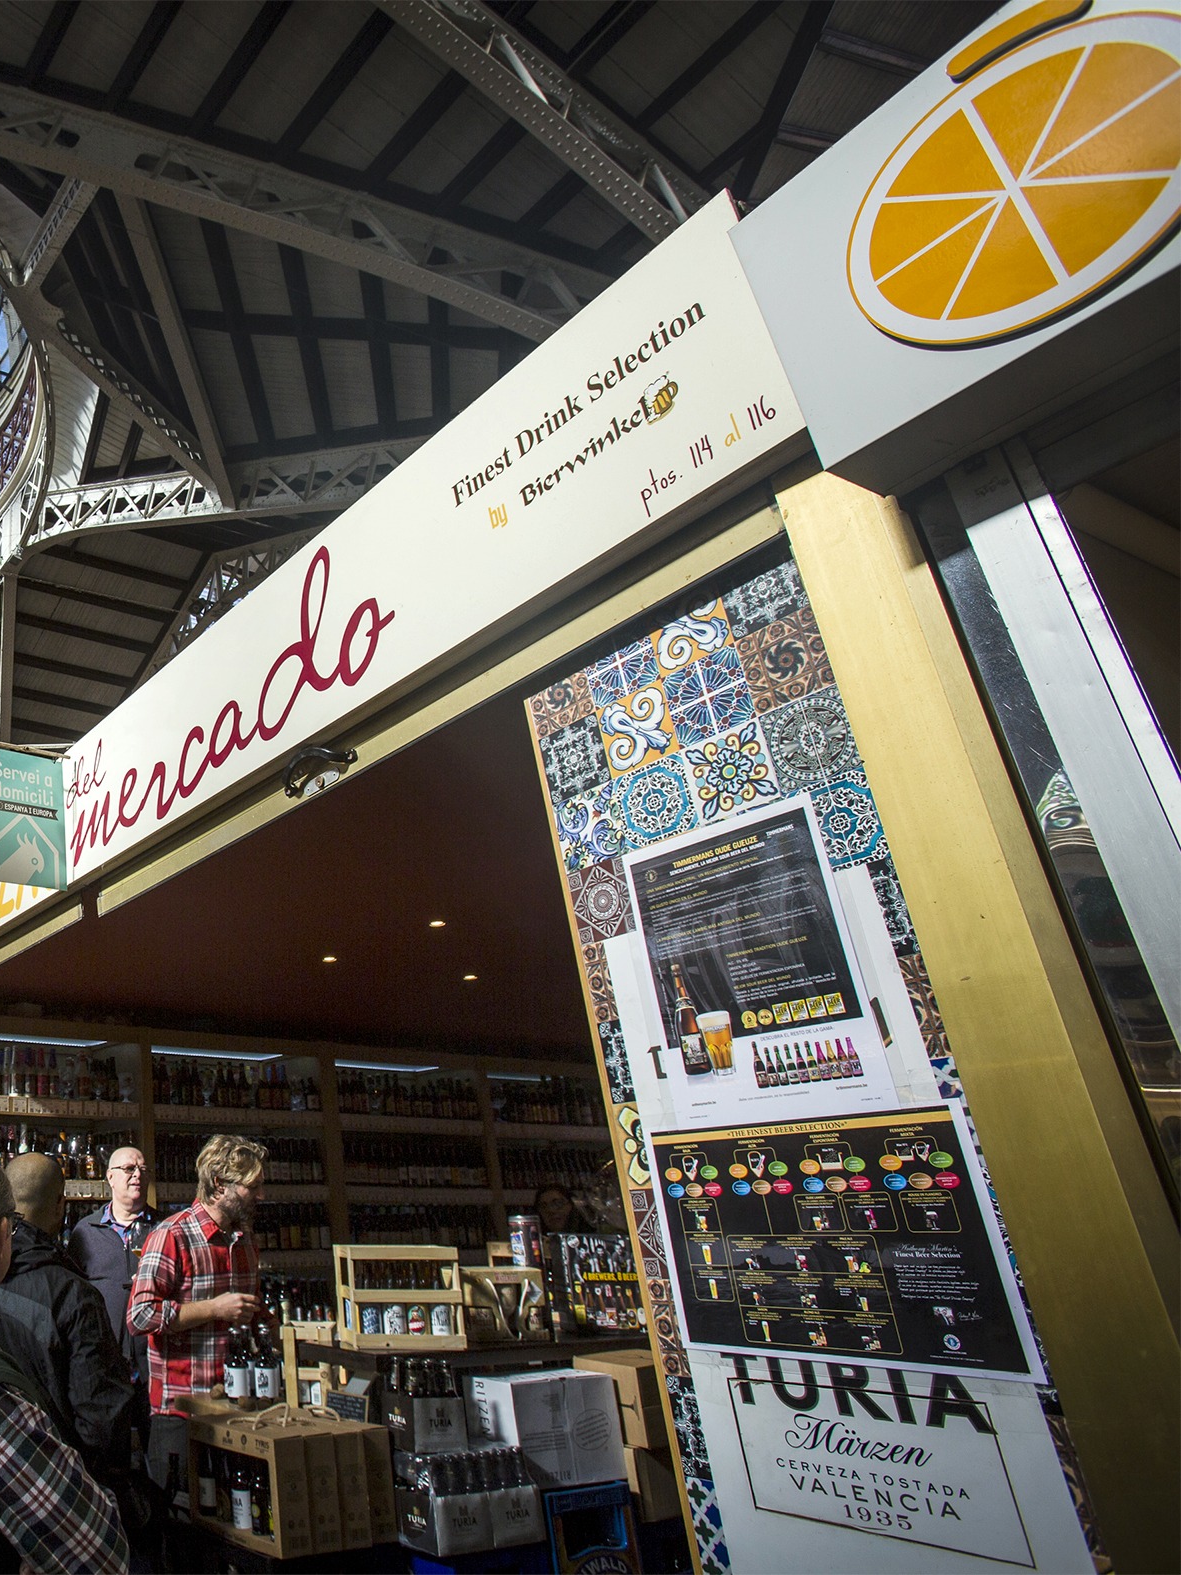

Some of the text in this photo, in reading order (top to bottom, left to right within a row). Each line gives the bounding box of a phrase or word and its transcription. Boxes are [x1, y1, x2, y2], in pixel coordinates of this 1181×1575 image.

[451, 302, 706, 508] Finest Drink Selection
[488, 396, 651, 529] by Bierwinkel
[640, 395, 776, 517] ptos. 114 al 116
[70, 545, 395, 868] mercado
[44, 775, 53, 788] a
[66, 738, 107, 809] del
[4, 803, 29, 814] ESPANYA
[33, 807, 54, 818] EUROPA
[672, 834, 758, 868] TIMMERMANS OUDE GUEUZE
[773, 1125, 794, 1133] BEER
[720, 1352, 998, 1435] TURIA
[388, 1413, 406, 1425] TURIA
[429, 1418, 453, 1428] TURIA
[785, 1413, 932, 1467] Märzen
[776, 1458, 970, 1500] CERVEZA TOSTADA
[789, 1473, 961, 1520] VALENCIA
[452, 1516, 477, 1528] TURIA
[506, 1508, 531, 1520] TURIA
[843, 1504, 912, 1531] 1935
